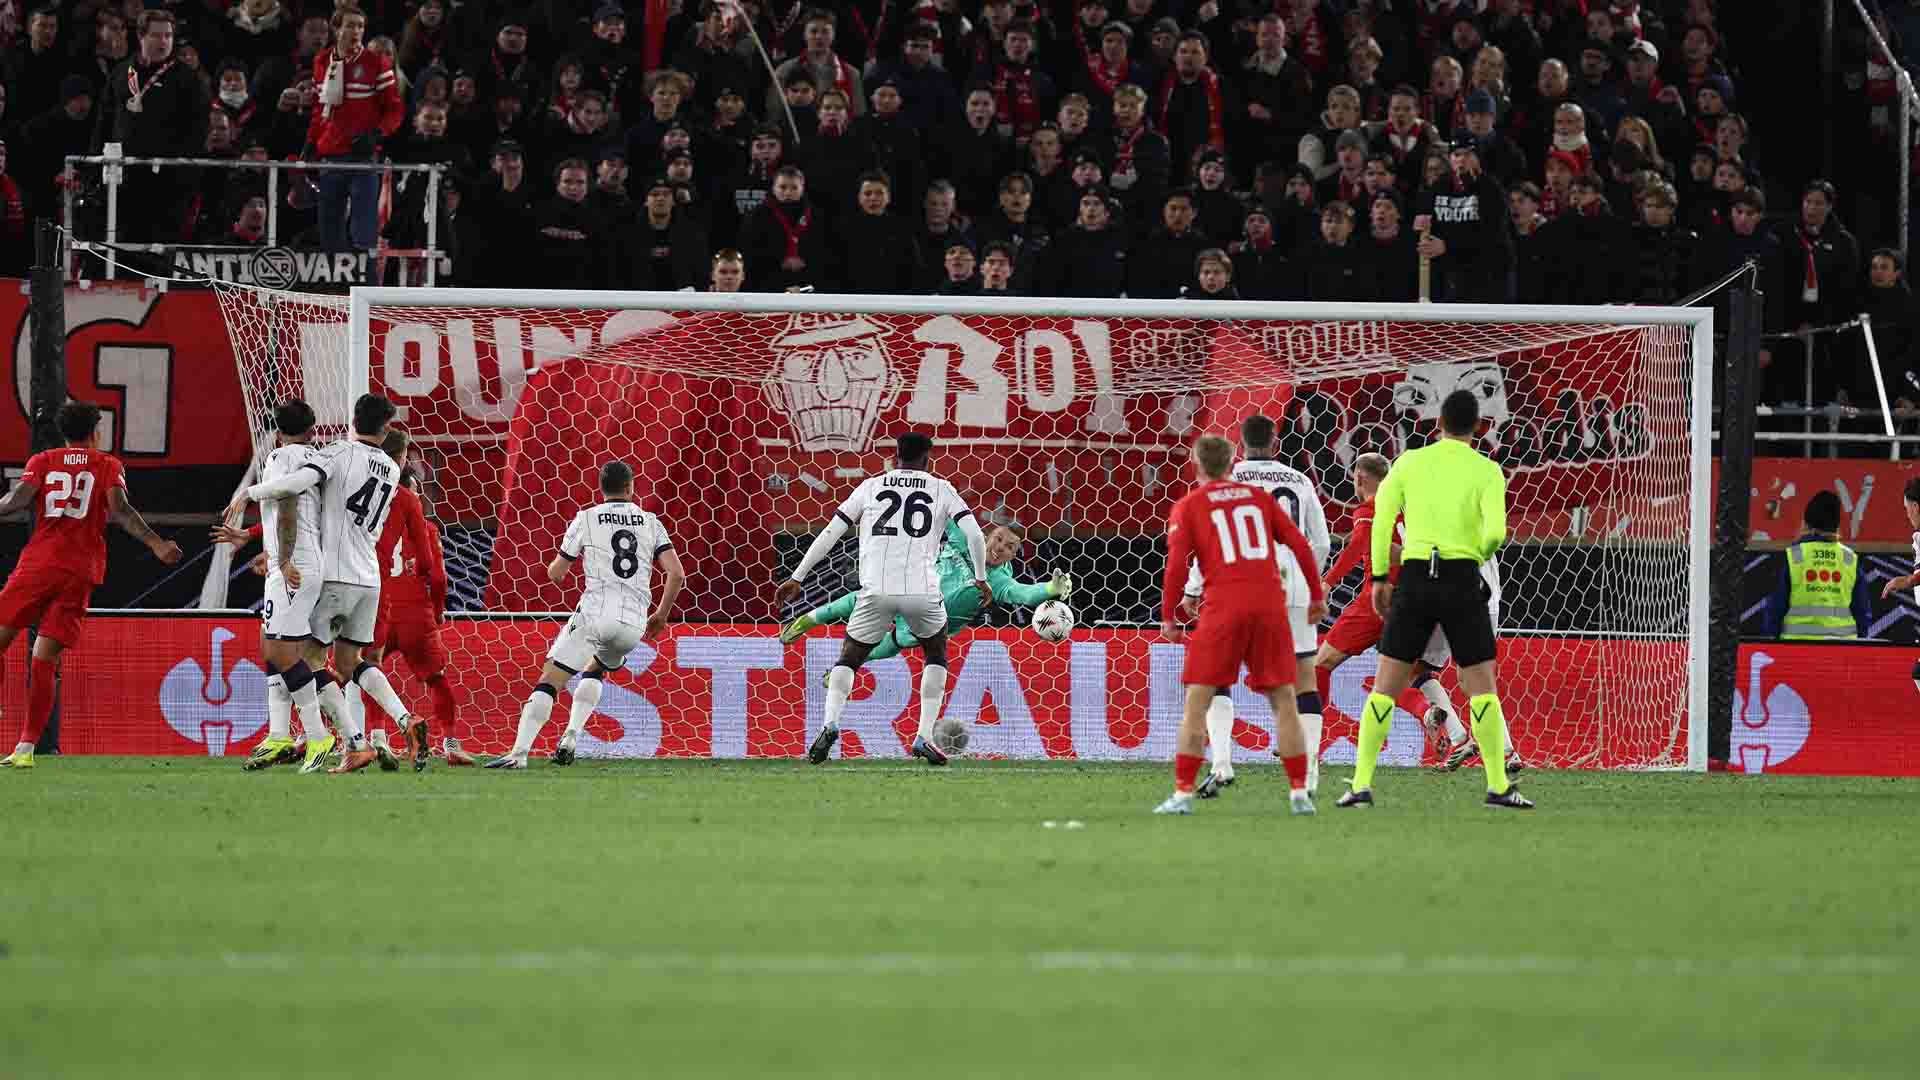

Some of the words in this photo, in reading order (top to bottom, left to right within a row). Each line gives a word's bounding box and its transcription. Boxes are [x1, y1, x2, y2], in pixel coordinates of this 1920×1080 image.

[173, 251, 251, 283] ANTI
[295, 252, 368, 283] VAR!
[63, 453, 88, 465] NOAH
[1236, 471, 1305, 485] BERNARDESC
[44, 470, 96, 520] 29
[345, 476, 393, 533] 41
[598, 513, 645, 526] FREULER
[871, 489, 934, 538] 26
[611, 529, 639, 579] 8
[1210, 504, 1269, 565] 10
